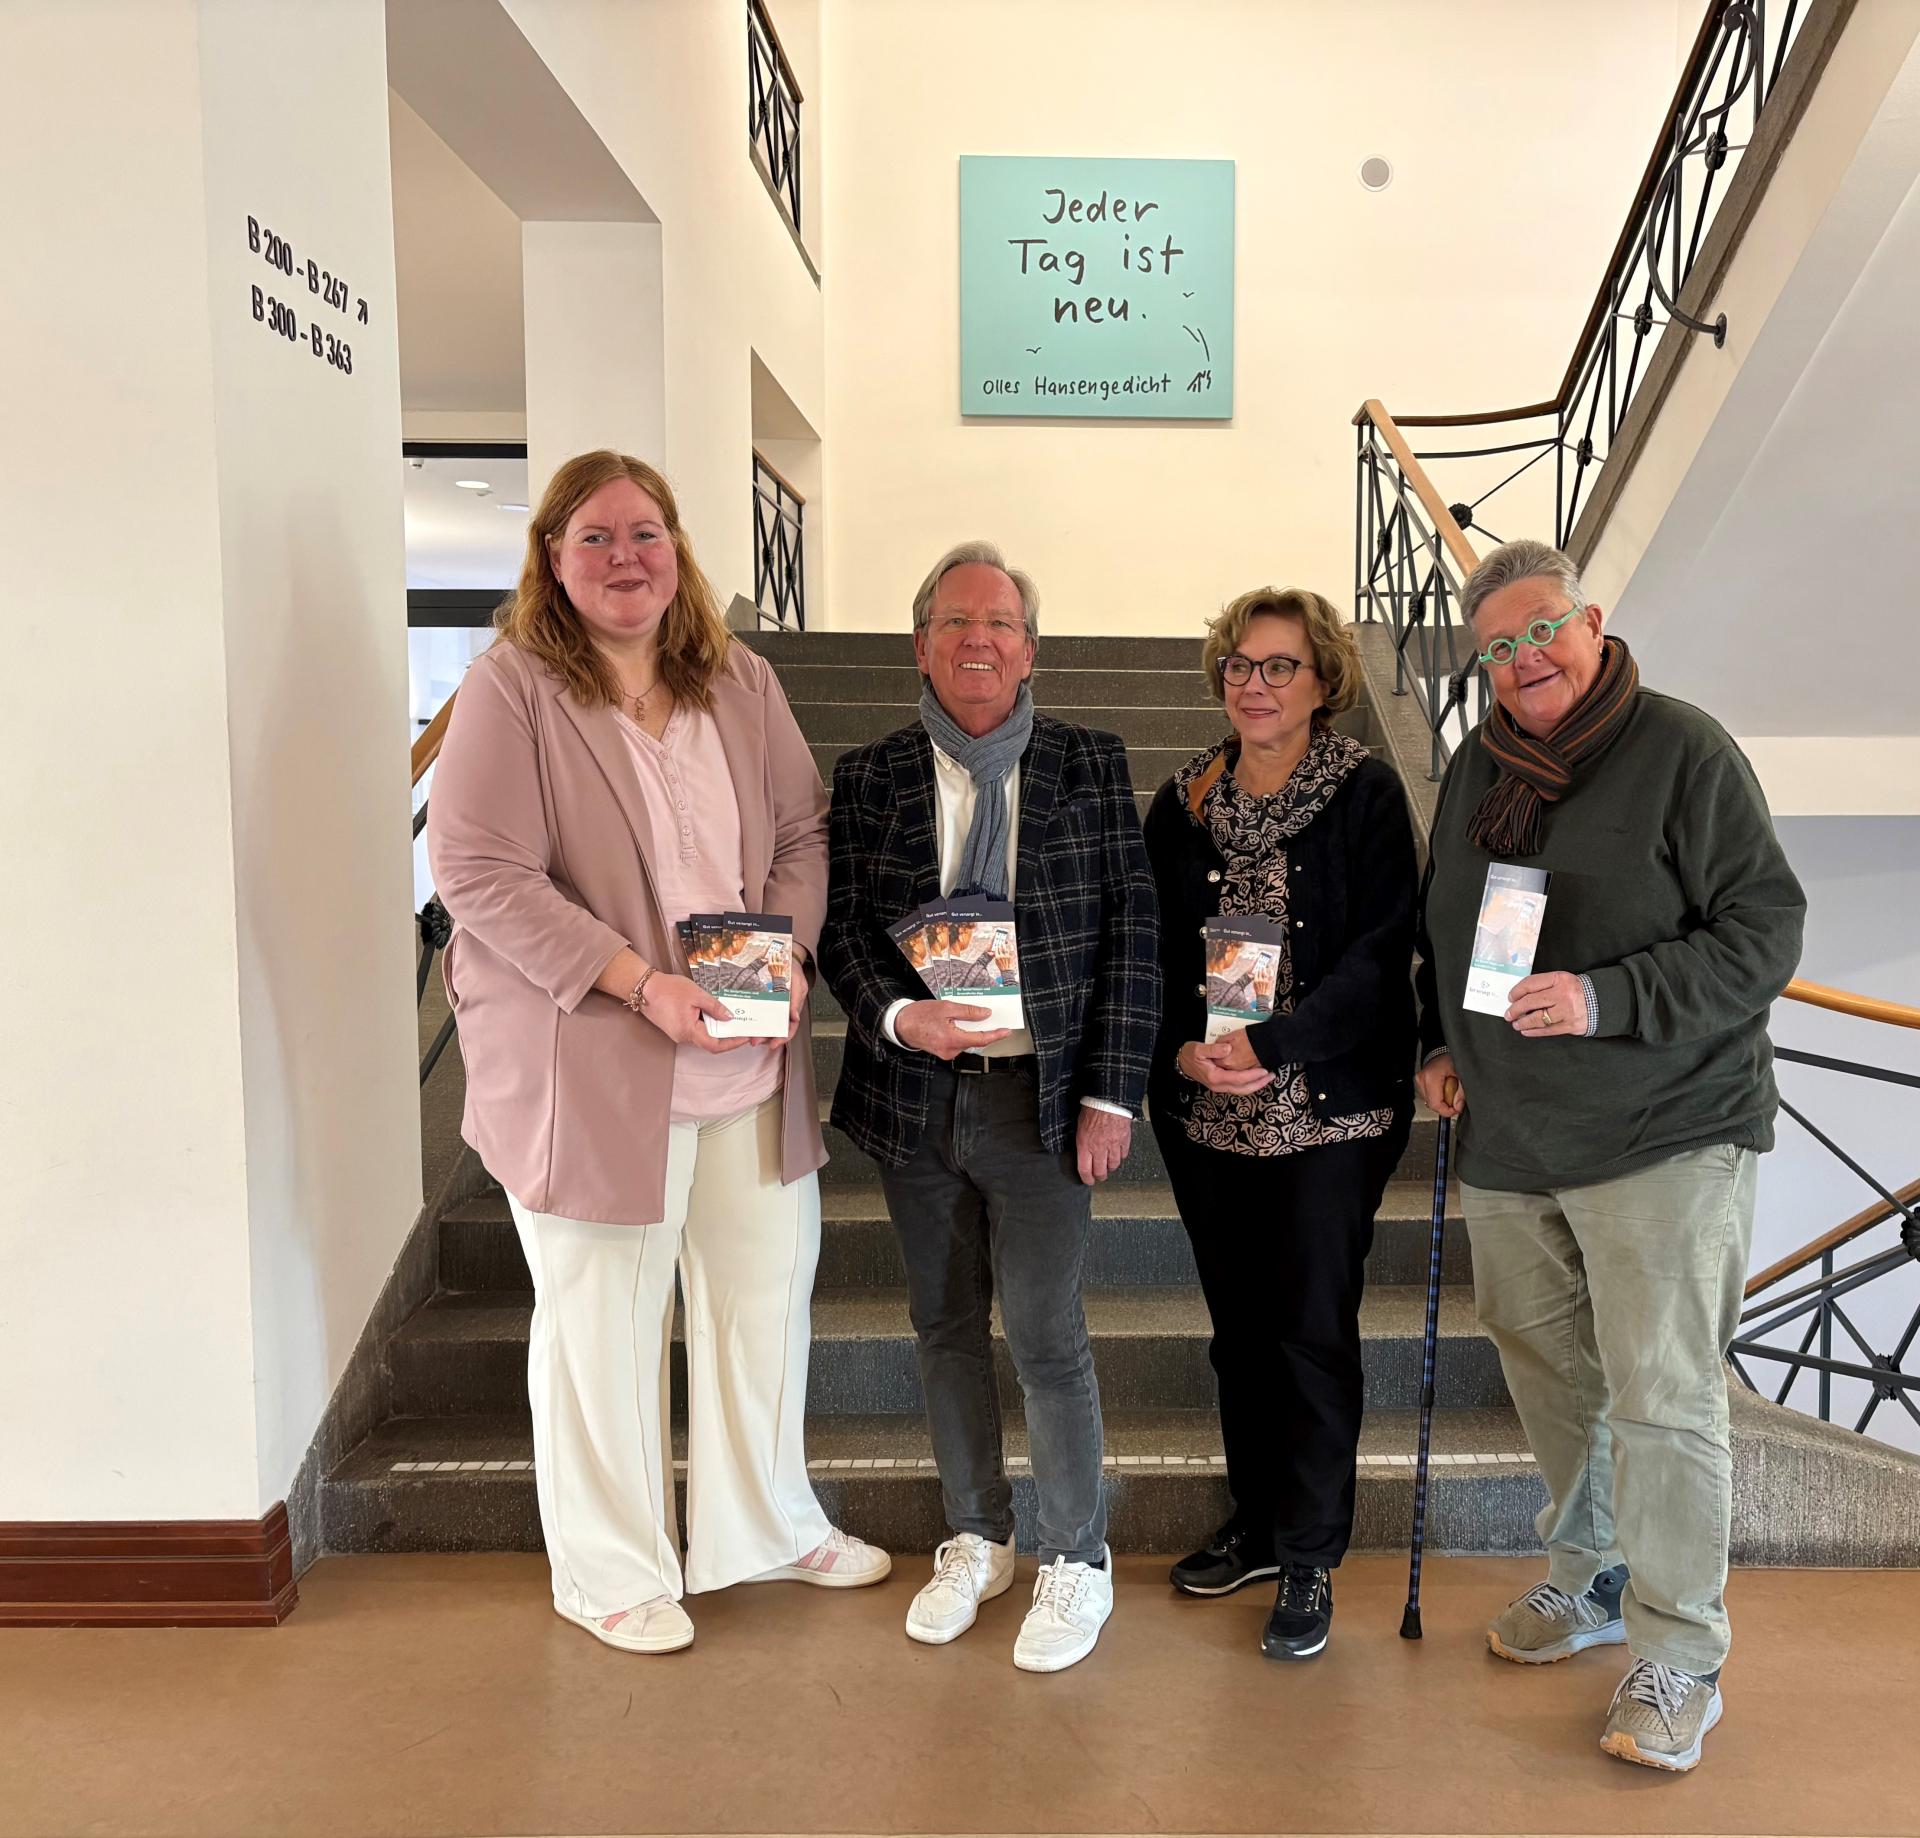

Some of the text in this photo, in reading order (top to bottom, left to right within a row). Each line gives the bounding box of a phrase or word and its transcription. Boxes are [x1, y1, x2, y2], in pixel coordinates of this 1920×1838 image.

[1042, 188, 1159, 224] Jeder
[247, 215, 261, 253] B
[263, 229, 293, 276] 200
[307, 259, 319, 294] B
[322, 271, 348, 313] 267
[1008, 233, 1184, 285] Tag ist
[252, 284, 264, 321] B
[267, 296, 296, 342] 300
[311, 323, 323, 357] B
[326, 334, 352, 375] 363
[1054, 296, 1147, 323] neu.
[1034, 372, 1171, 401] Hansengedicht
